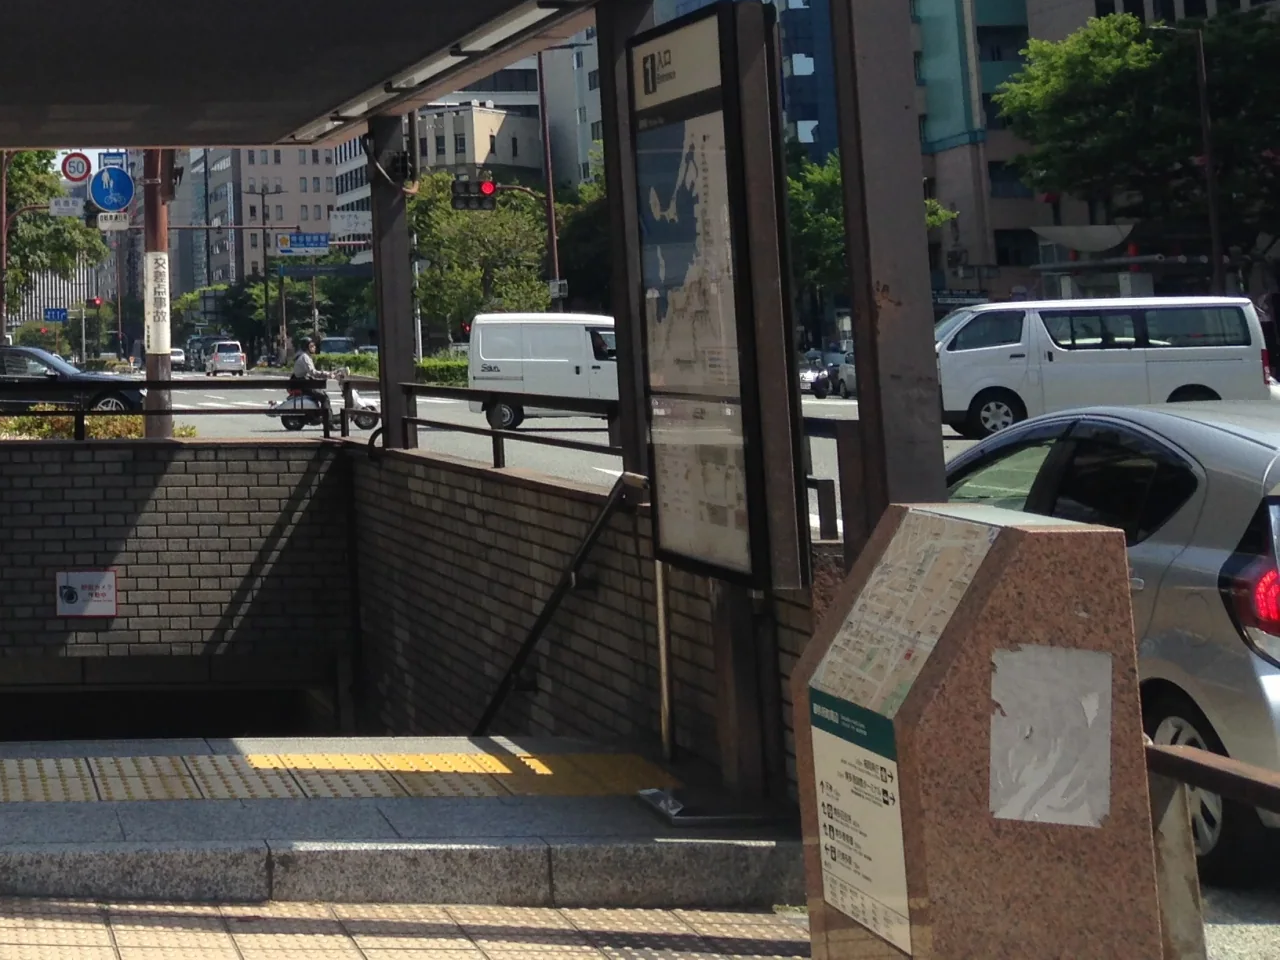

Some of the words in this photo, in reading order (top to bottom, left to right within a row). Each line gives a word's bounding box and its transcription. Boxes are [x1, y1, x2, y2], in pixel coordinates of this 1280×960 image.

[657, 49, 671, 70] 入口
[68, 160, 85, 174] 50
[152, 257, 167, 323] 交差点事故
